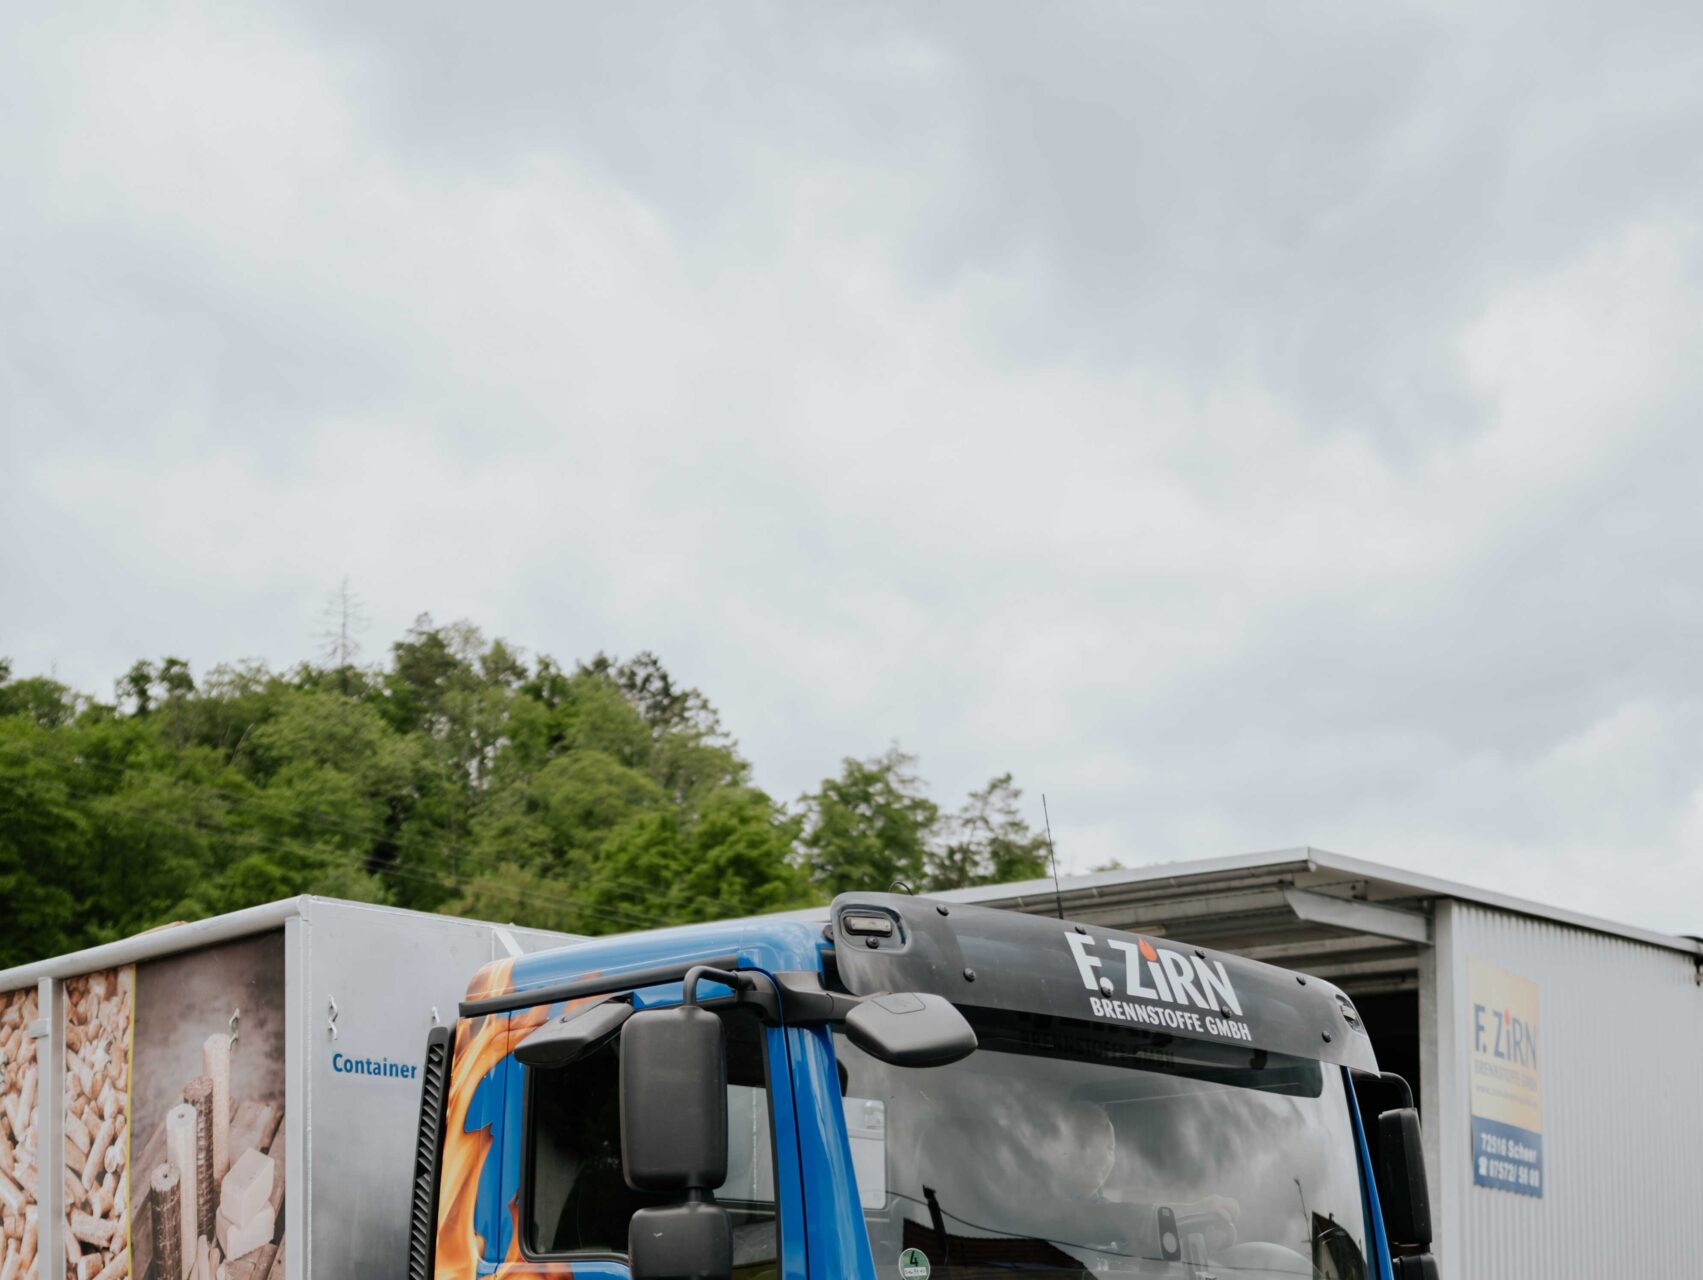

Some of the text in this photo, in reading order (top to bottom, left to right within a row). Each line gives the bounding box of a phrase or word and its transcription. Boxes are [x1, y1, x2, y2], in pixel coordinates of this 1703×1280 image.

[1090, 997, 1252, 1041] BRENNSTOFFE GMBH
[1474, 1003, 1487, 1054] F.
[333, 1053, 417, 1079] Container
[910, 1250, 919, 1266] 4
